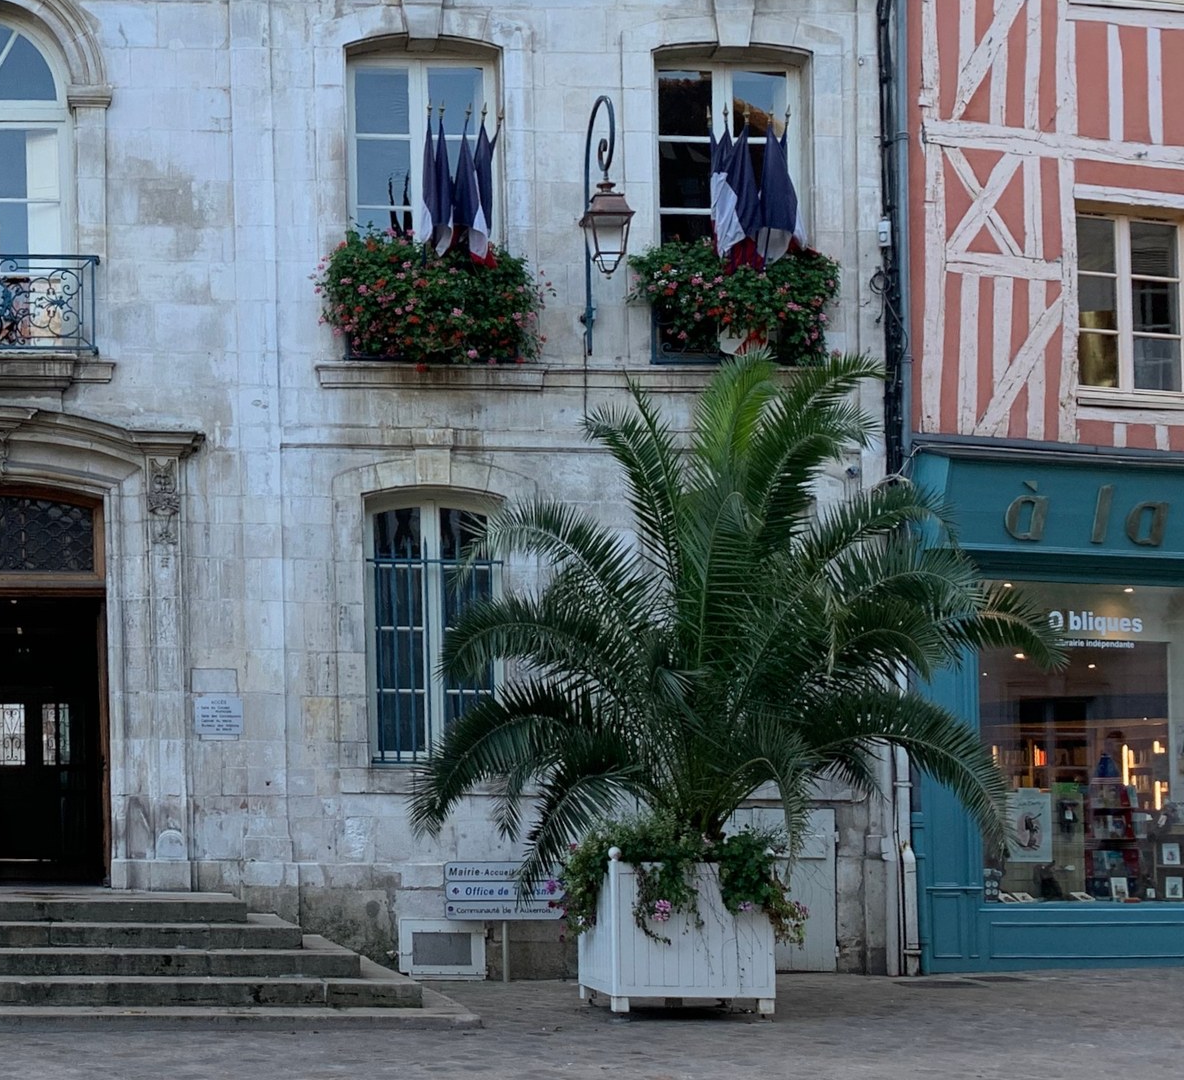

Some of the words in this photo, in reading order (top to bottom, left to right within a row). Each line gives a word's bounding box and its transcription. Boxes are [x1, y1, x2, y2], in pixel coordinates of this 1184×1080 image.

[1005, 480, 1050, 542] à
[1090, 483, 1170, 547] la
[1086, 639, 1135, 649] indépendante
[465, 886, 495, 896] Office
[497, 886, 509, 896] de
[456, 906, 500, 914] Communauté
[502, 905, 512, 914] de
